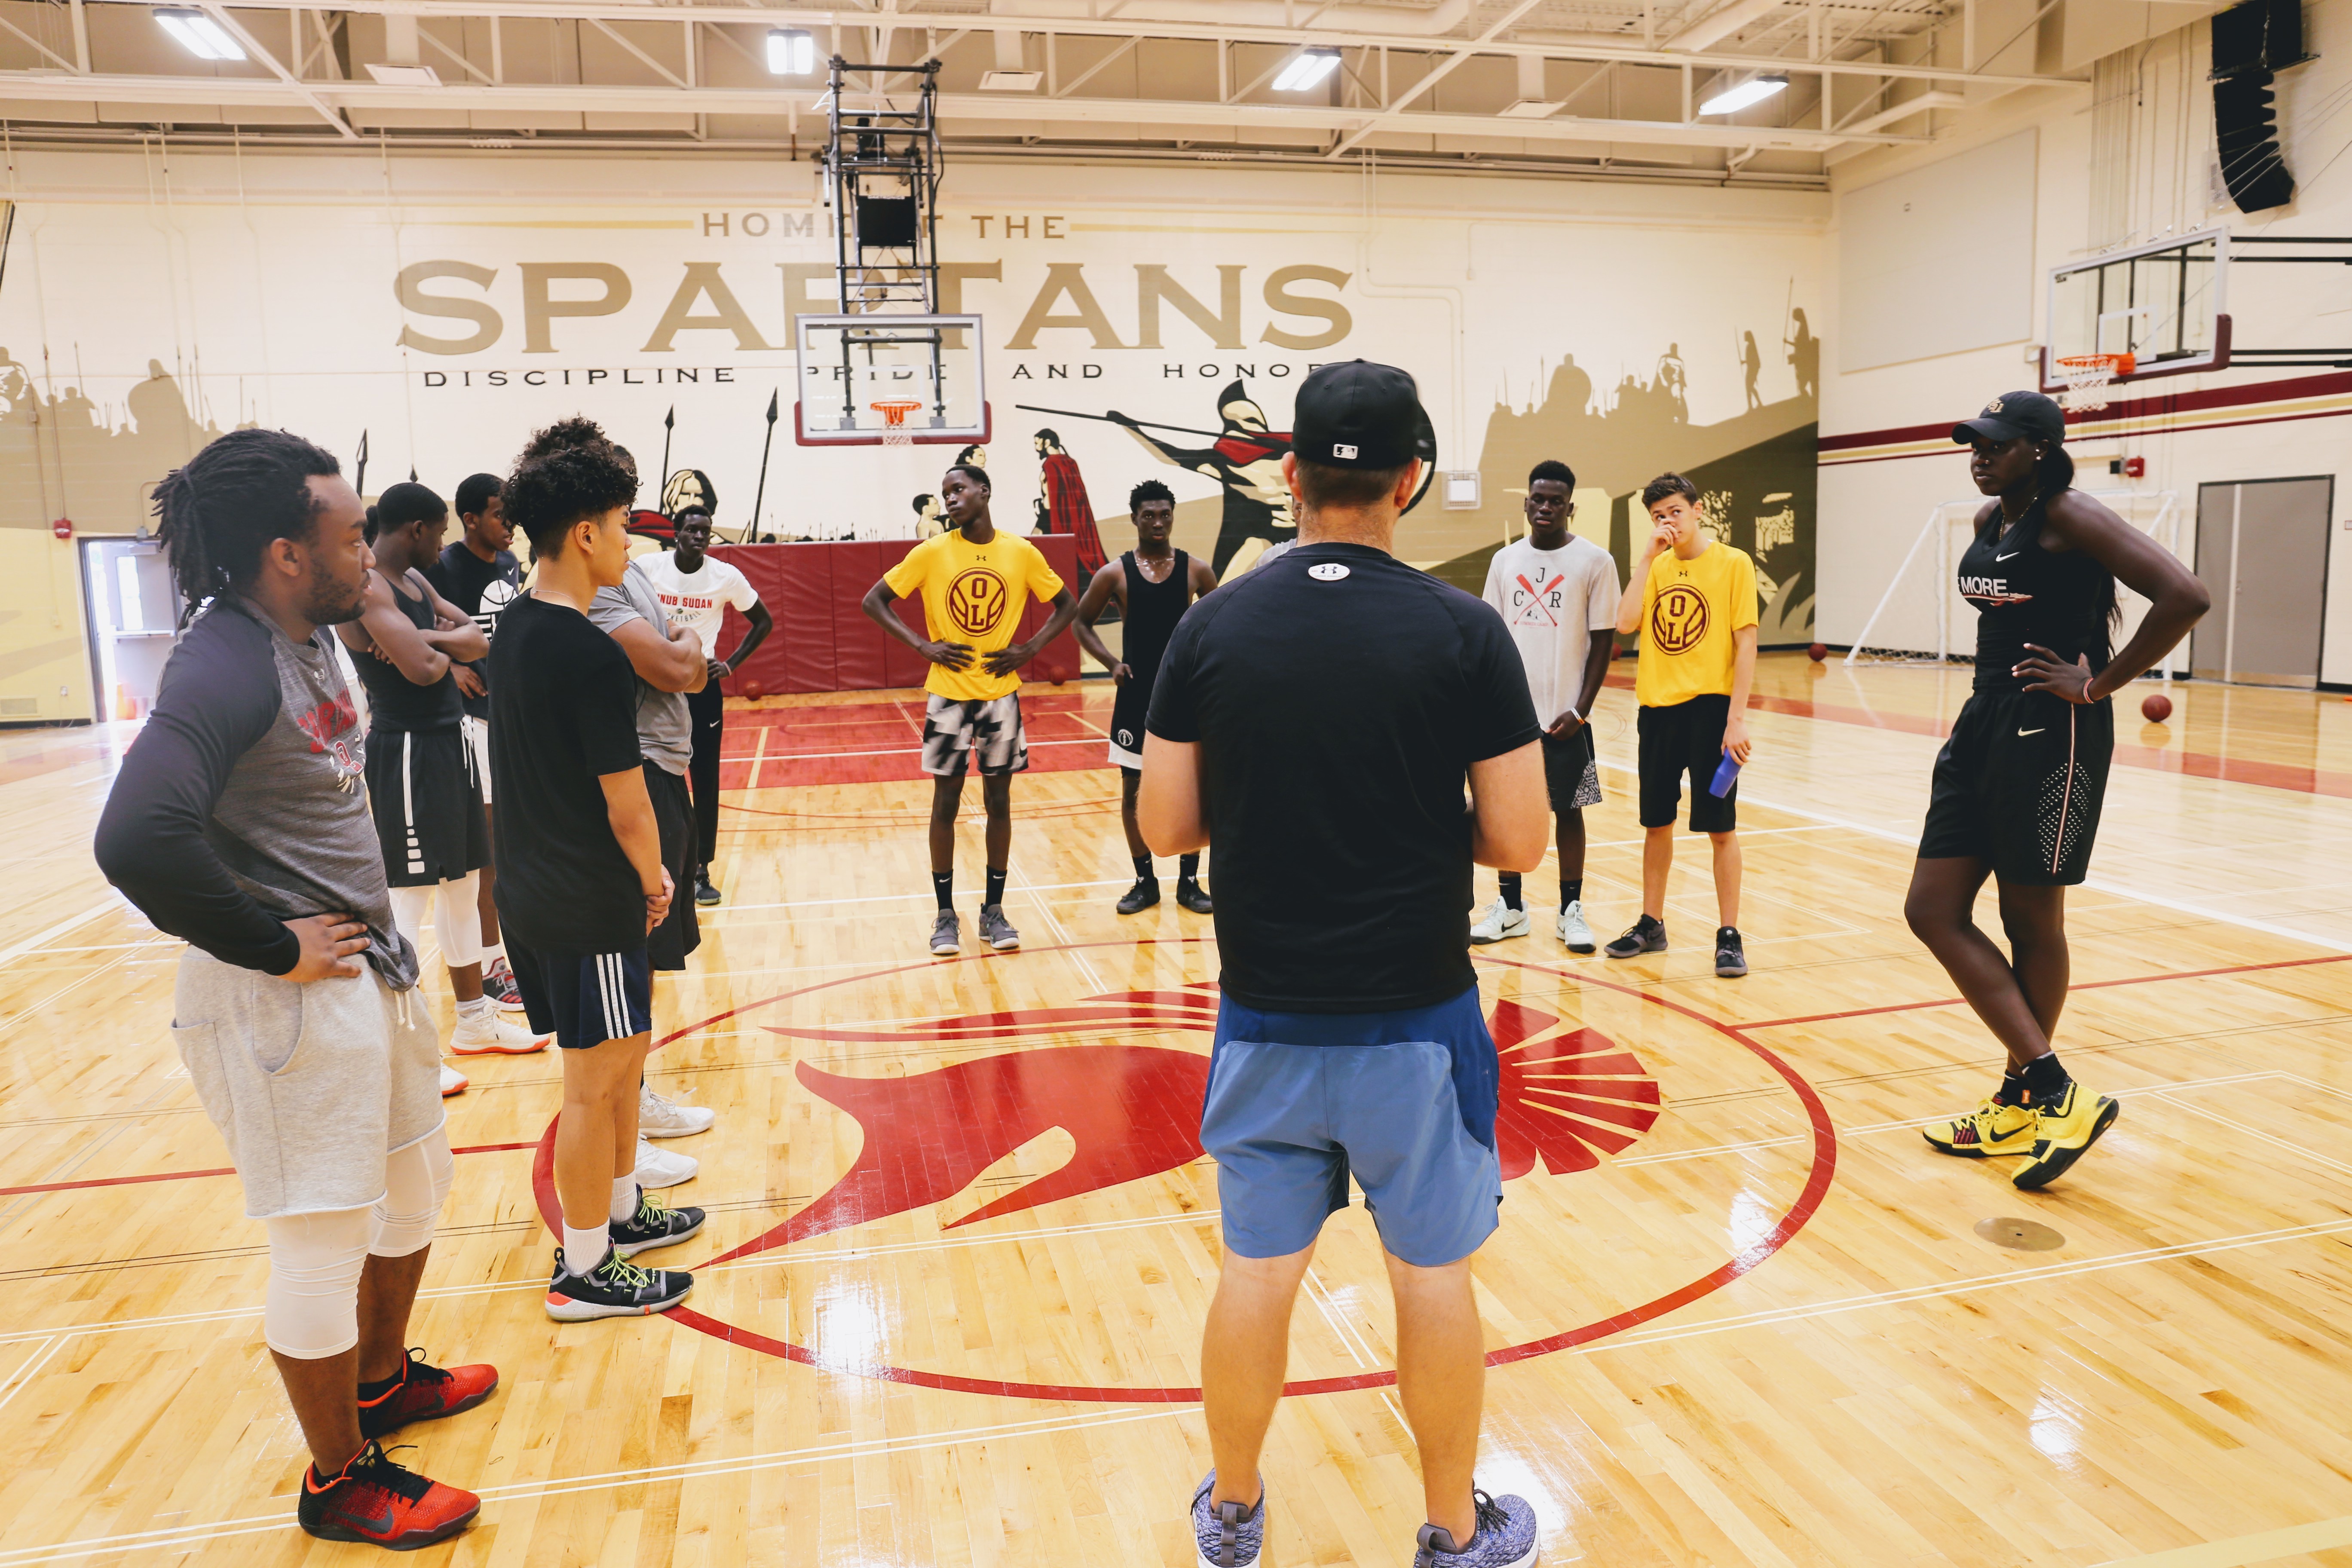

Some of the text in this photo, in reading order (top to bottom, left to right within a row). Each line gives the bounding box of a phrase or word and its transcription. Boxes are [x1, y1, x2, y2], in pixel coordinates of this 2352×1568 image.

[971, 215, 1065, 239] THE
[393, 259, 1353, 355] SPARTANS
[424, 368, 735, 387] DISCIPLINE
[1011, 364, 1102, 379] AND
[1536, 567, 1545, 583] J
[1960, 576, 2009, 597] MORE
[682, 597, 713, 609] SUDAN
[1513, 590, 1562, 608] C R
